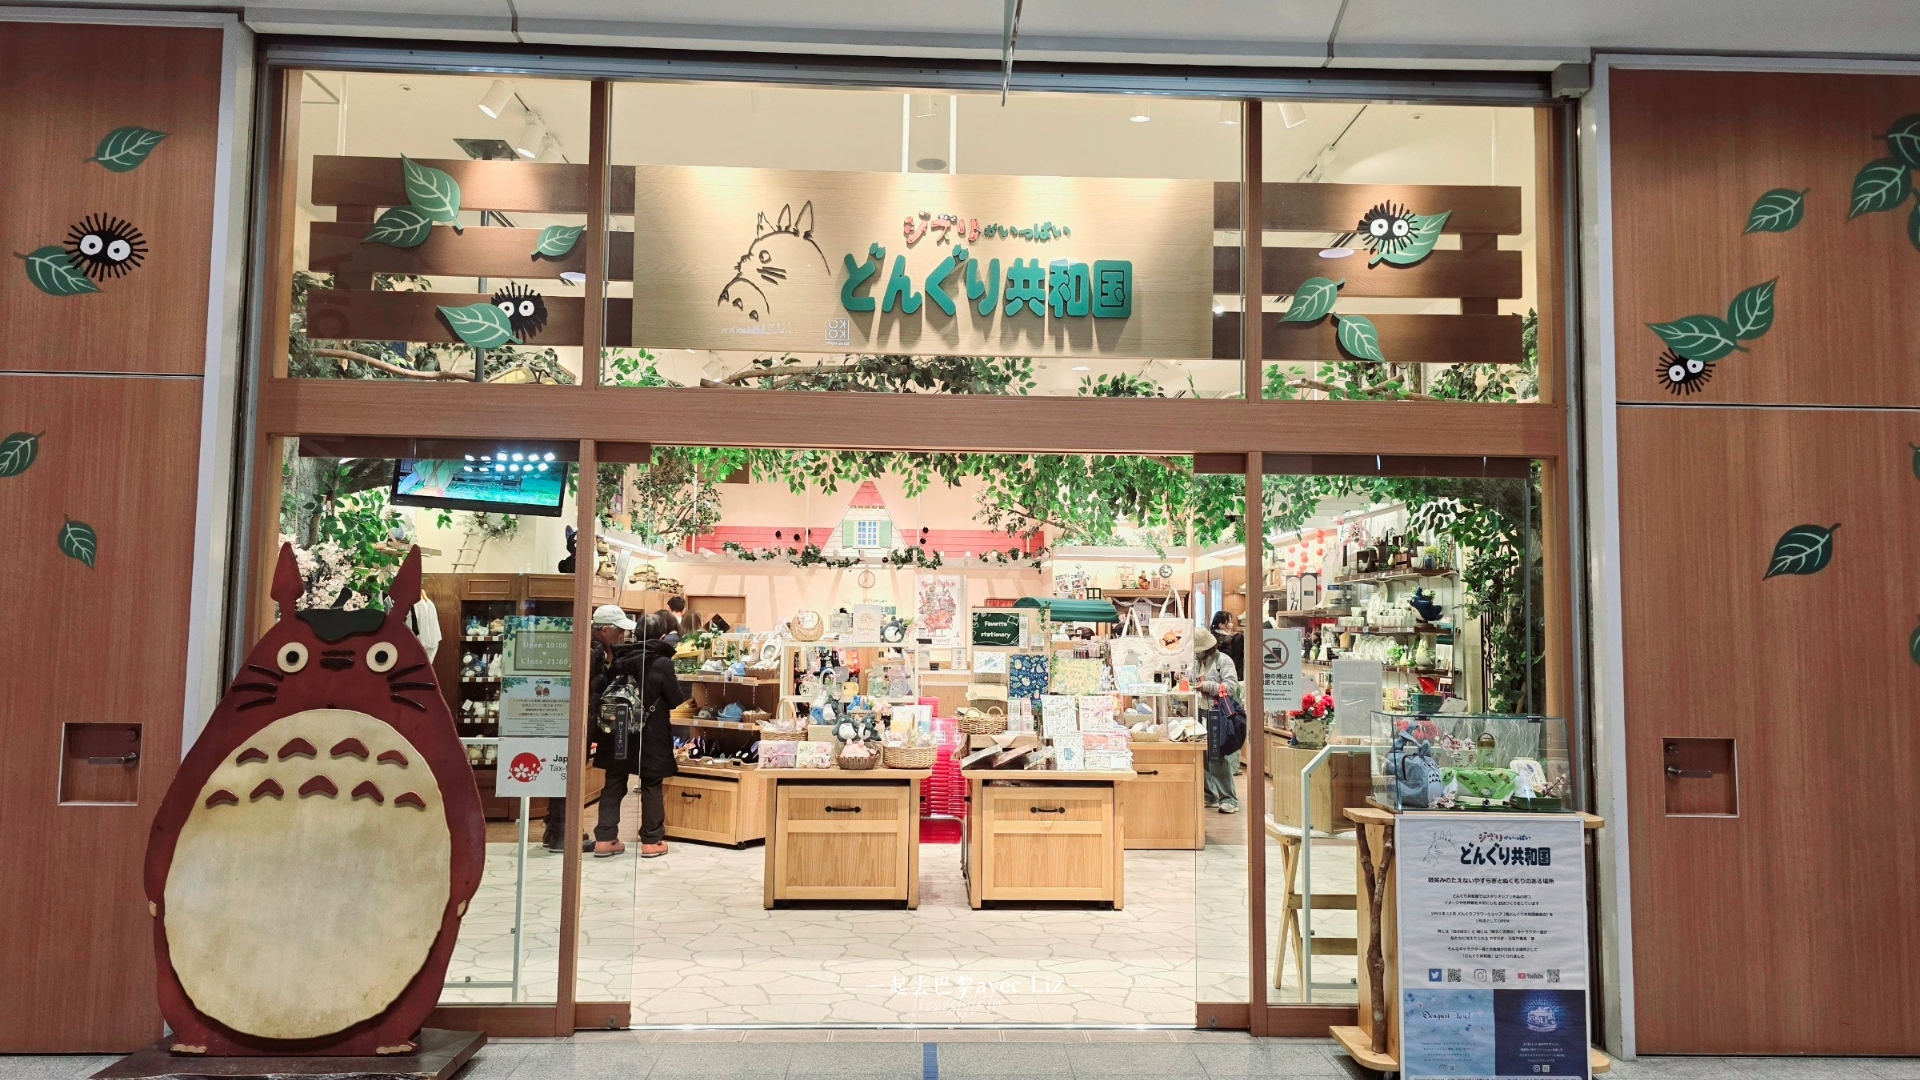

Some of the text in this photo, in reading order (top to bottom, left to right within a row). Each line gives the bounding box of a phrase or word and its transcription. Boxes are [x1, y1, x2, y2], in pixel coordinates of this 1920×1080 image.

[903, 210, 1072, 245] ジブリがいっぱい
[841, 242, 1133, 319] どんぐり共和国
[980, 631, 1011, 639] stationary
[553, 754, 568, 763] Jap
[549, 765, 568, 773] Tax-
[1460, 843, 1551, 866] どんぐり共和国
[1526, 972, 1544, 980] YouTube
